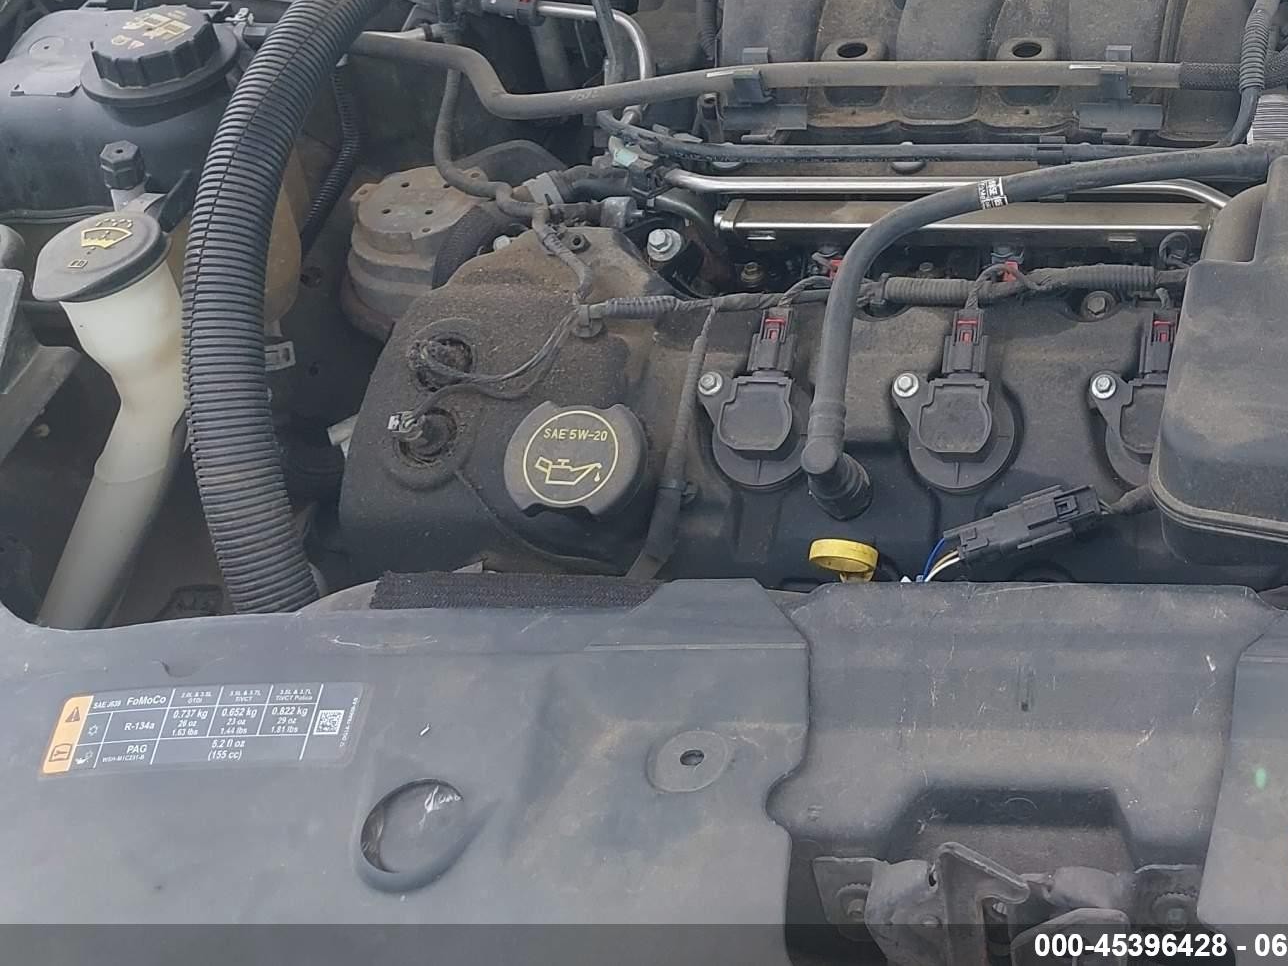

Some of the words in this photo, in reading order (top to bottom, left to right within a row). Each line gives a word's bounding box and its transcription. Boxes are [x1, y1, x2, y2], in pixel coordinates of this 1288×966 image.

[543, 427, 567, 440] SAE
[568, 428, 608, 442] 5W-20
[126, 694, 167, 706] FoMoCo
[173, 708, 197, 719] 0.737
[196, 708, 209, 720] kg
[221, 707, 245, 717] 0.652
[245, 706, 258, 718] kg
[296, 705, 309, 717] kg
[124, 721, 156, 731] R-134a
[187, 727, 199, 736] lbs
[235, 726, 248, 734] lbs
[286, 725, 299, 733] lbs
[211, 739, 226, 748] 5.2
[226, 738, 234, 748] fl
[233, 739, 246, 748] oz
[126, 744, 148, 754] PAG
[207, 749, 228, 762] (155
[228, 749, 243, 761] cc)
